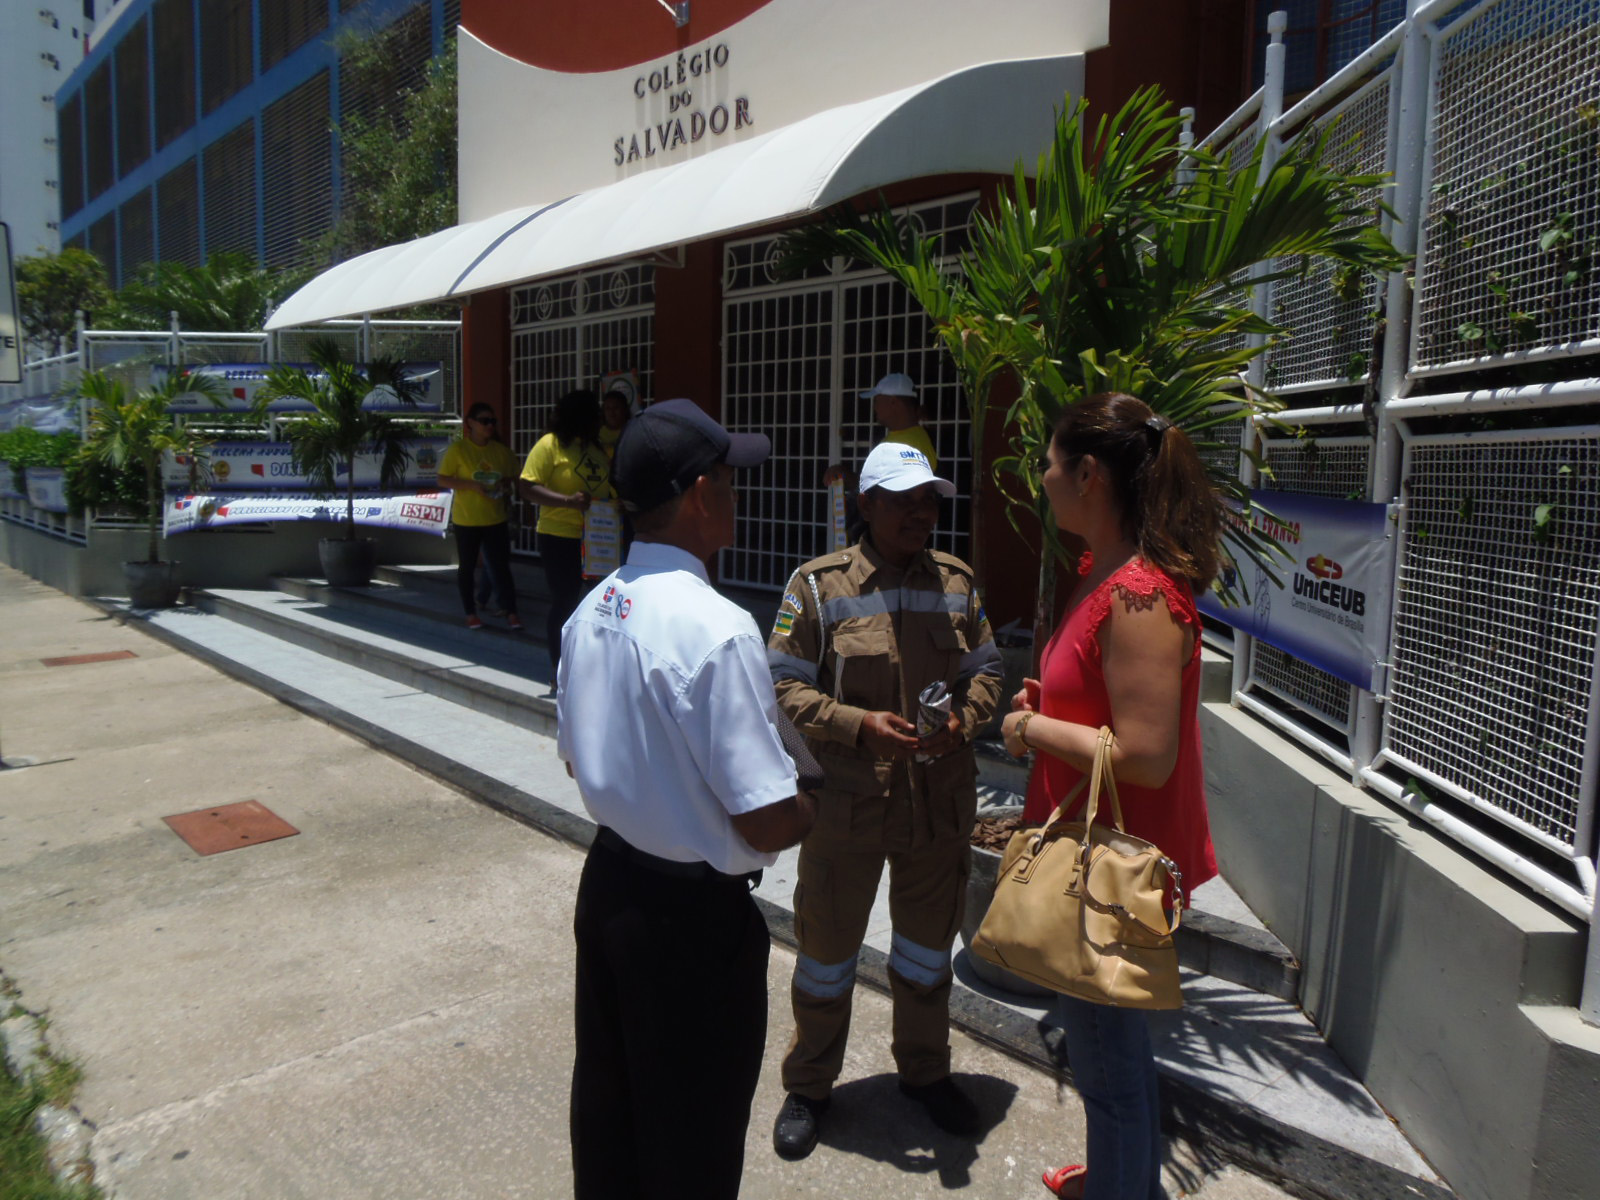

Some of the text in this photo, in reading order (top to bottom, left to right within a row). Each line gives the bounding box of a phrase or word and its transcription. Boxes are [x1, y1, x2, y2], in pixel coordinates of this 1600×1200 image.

[633, 43, 730, 99] COLÉGIO
[668, 90, 693, 114] DO
[613, 98, 754, 167] SALVADOR
[403, 503, 442, 522] ESPM
